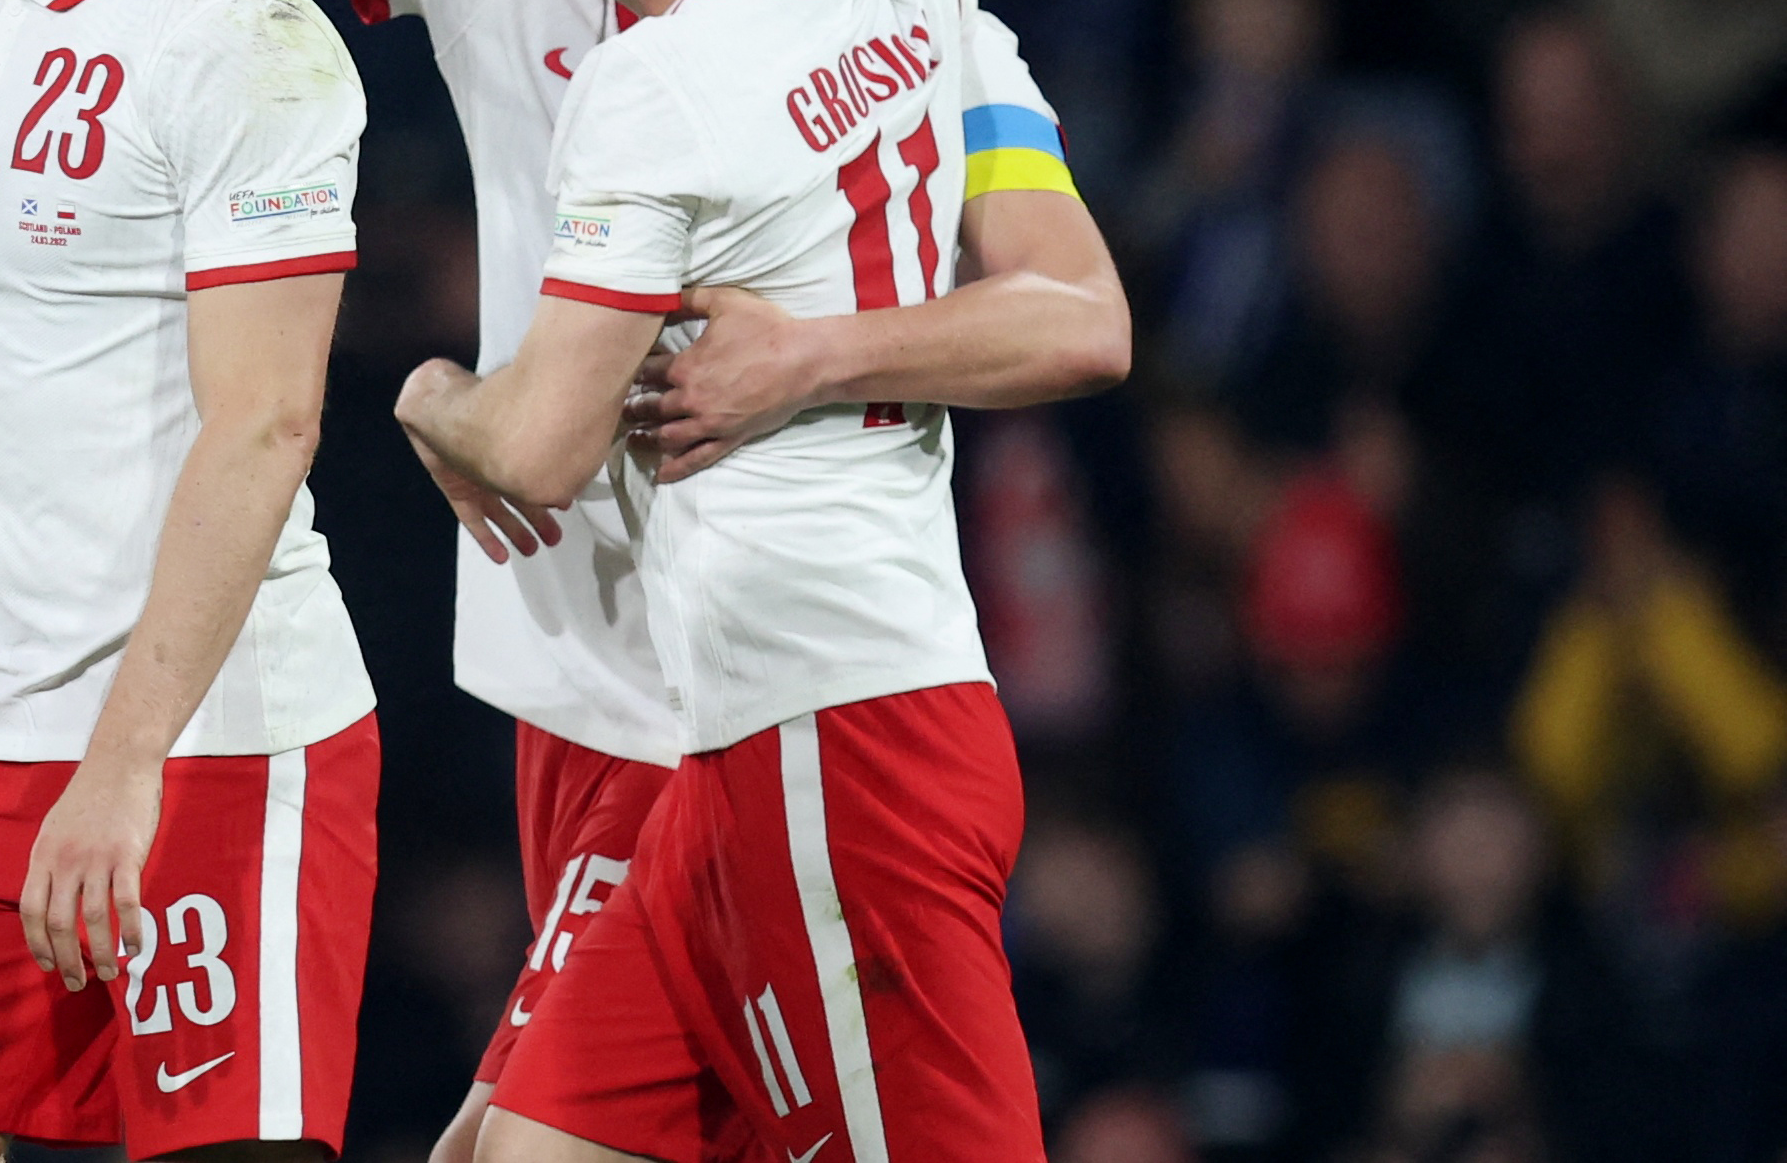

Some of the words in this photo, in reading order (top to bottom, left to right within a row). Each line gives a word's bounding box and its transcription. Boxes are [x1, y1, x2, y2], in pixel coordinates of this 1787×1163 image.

[11, 47, 124, 180] 23
[230, 190, 255, 201] UEFA
[231, 188, 338, 216] FOUNDATION
[837, 109, 940, 428] 11
[117, 893, 237, 1036] 23
[742, 981, 813, 1118] 11
